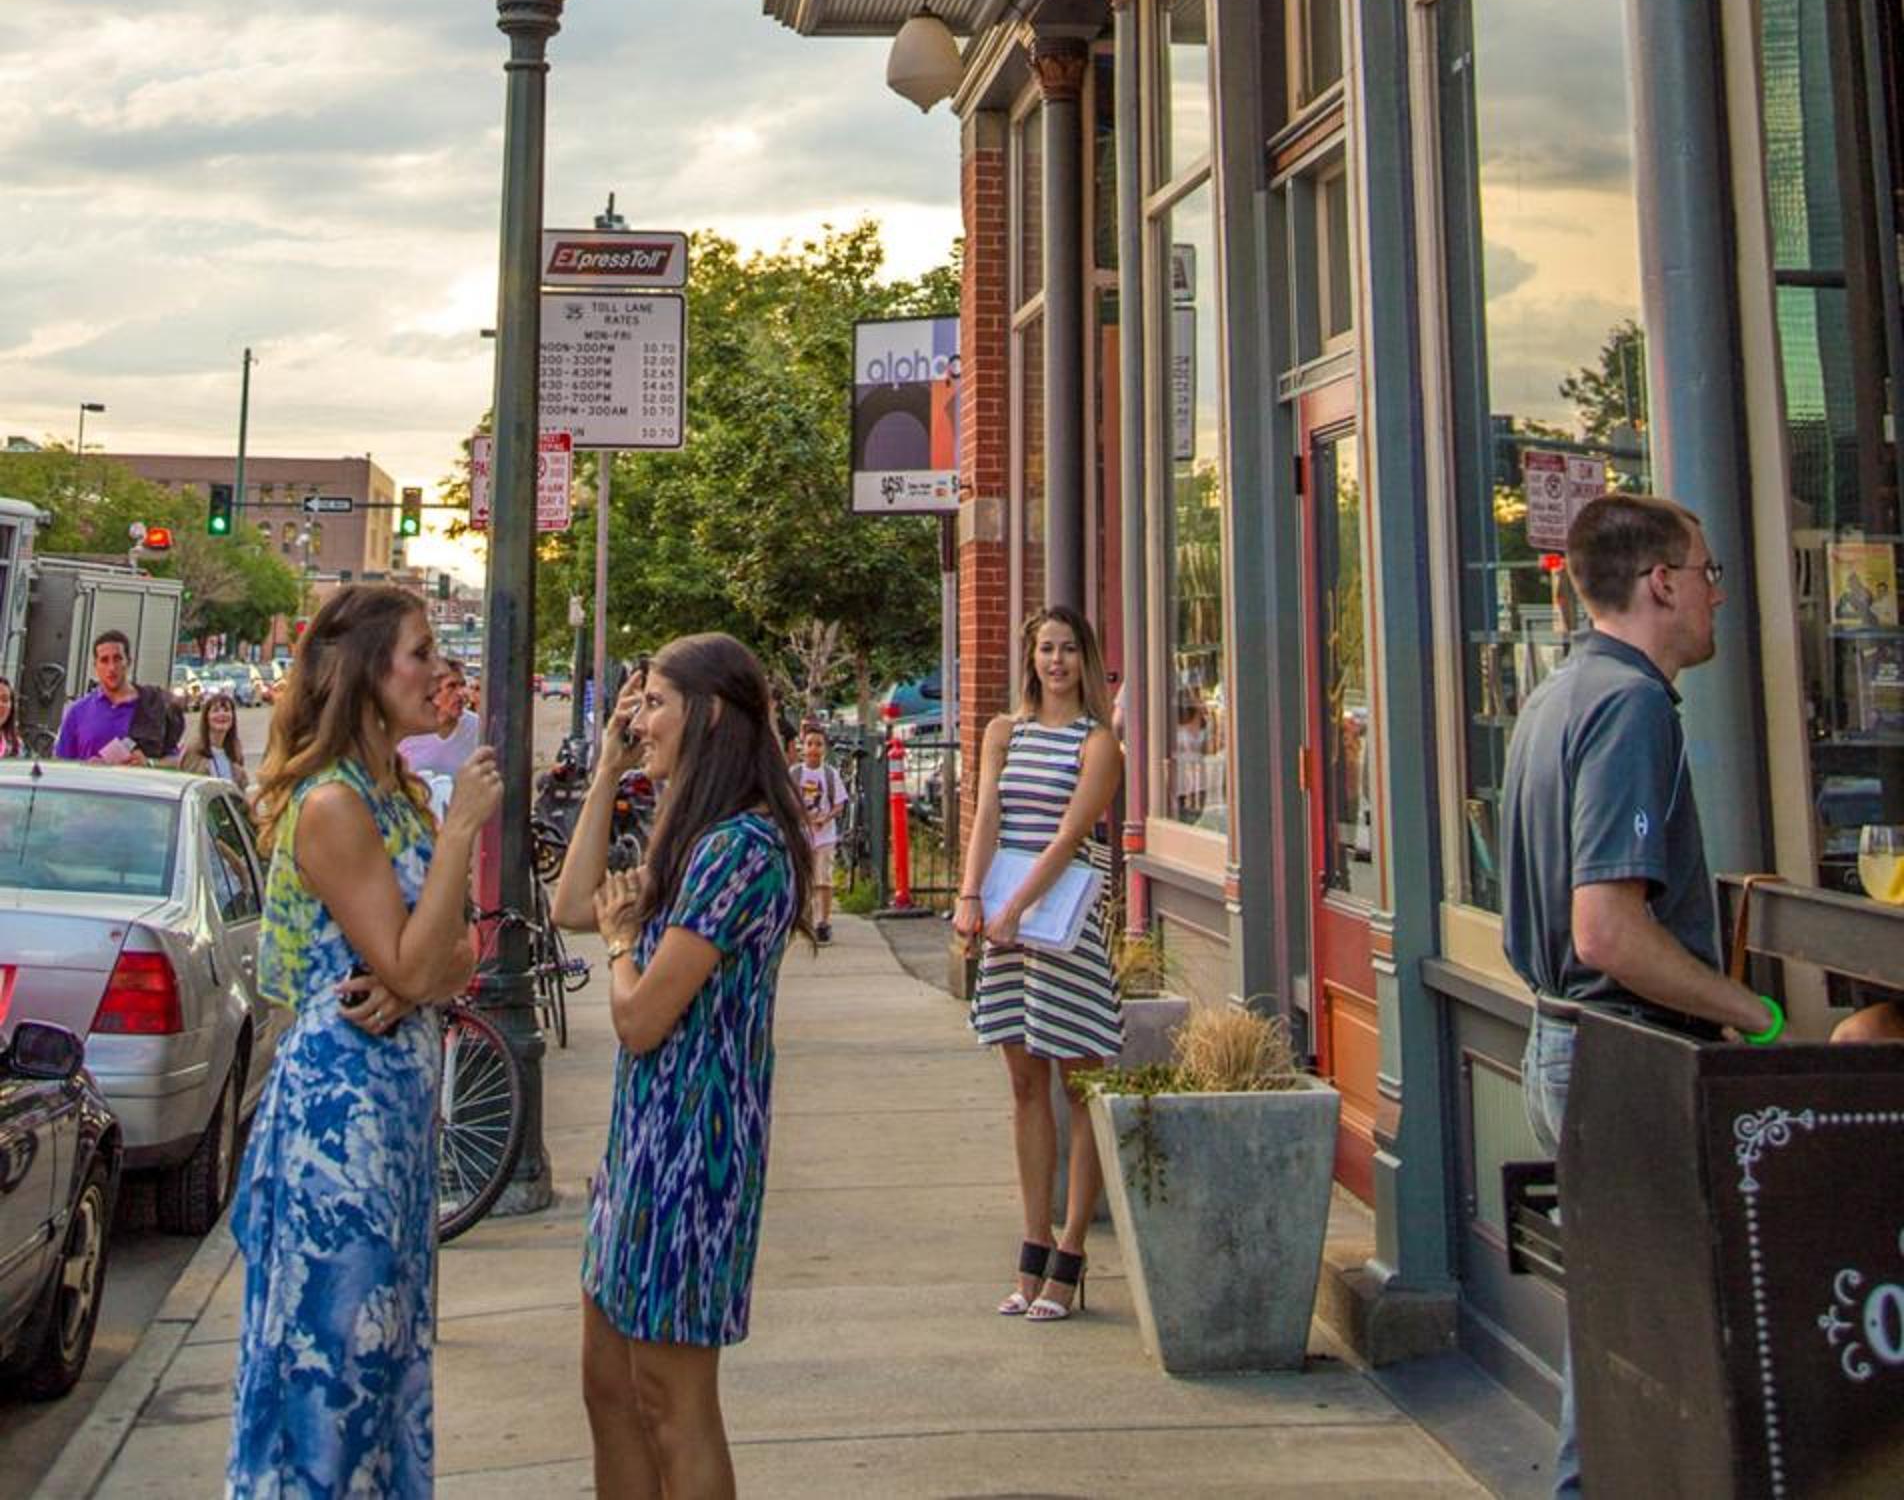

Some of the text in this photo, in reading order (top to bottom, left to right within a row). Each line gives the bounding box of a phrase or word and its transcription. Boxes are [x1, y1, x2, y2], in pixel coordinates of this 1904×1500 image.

[592, 302, 654, 314] TOLL LANE
[604, 315, 640, 325] RATES
